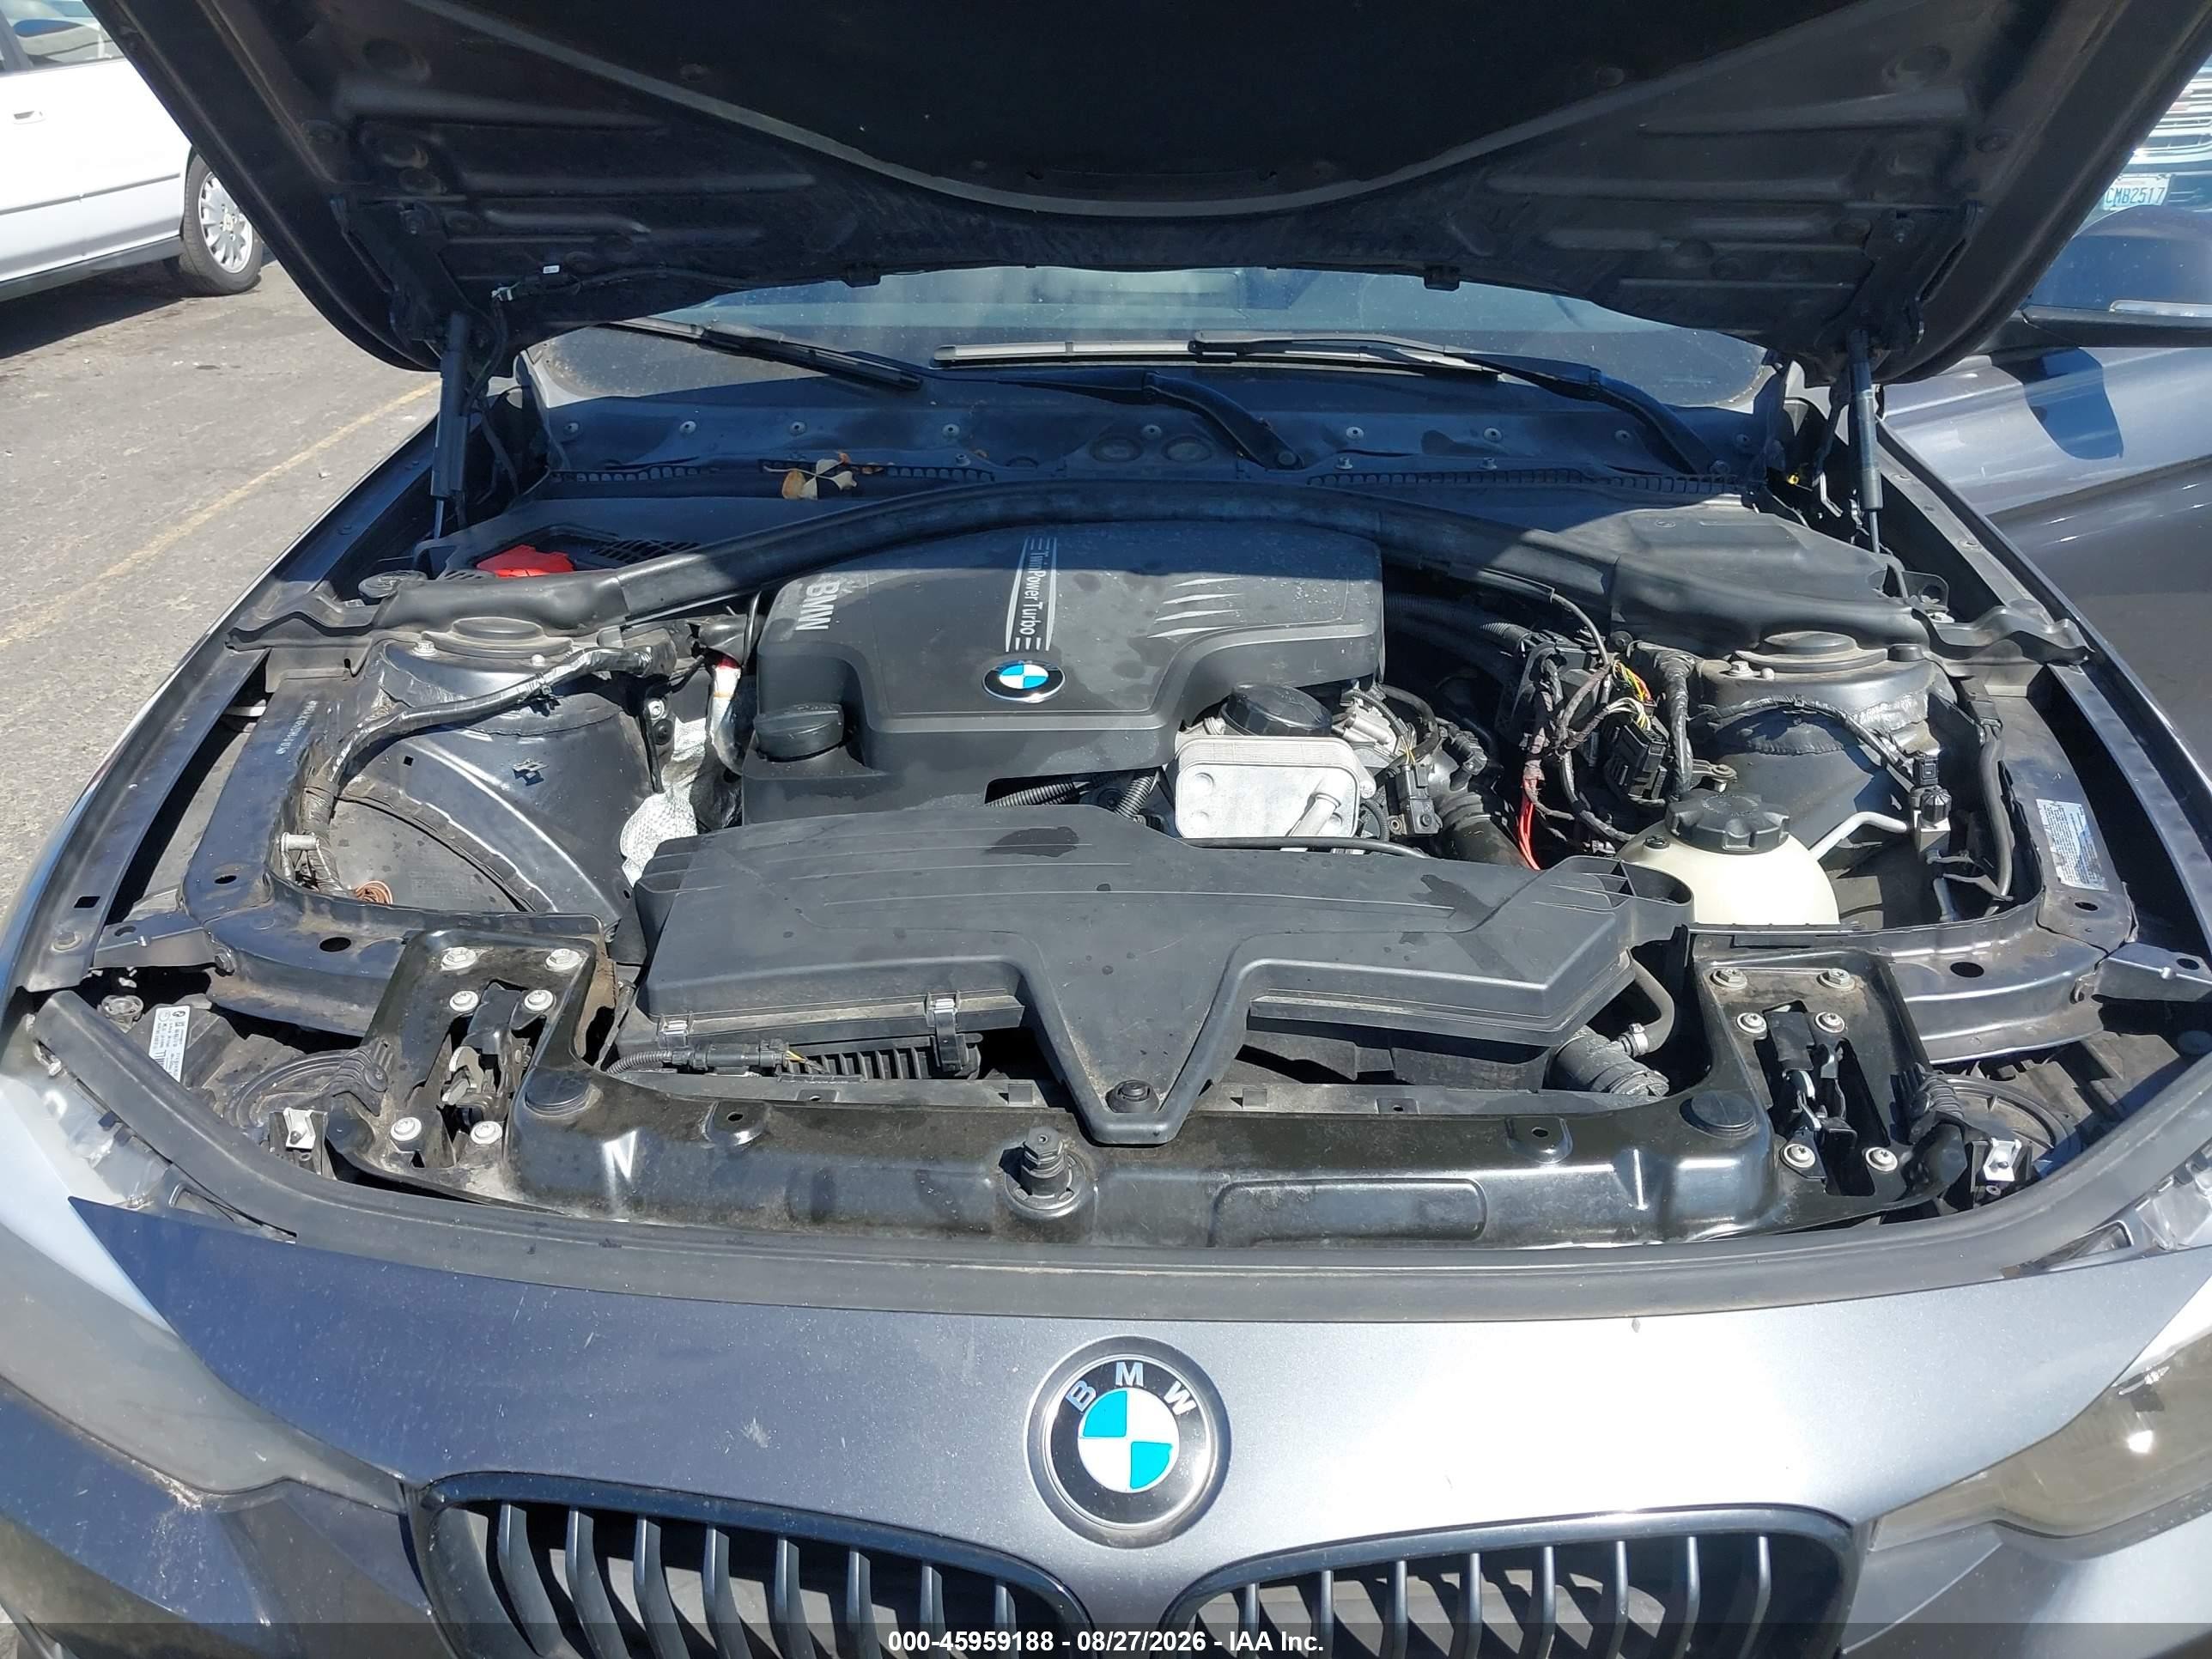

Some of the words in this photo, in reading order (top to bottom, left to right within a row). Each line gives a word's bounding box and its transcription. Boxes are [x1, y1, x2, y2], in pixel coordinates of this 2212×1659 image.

[795, 580, 839, 630] BMW
[1019, 602, 1043, 635] Turbo
[1066, 1362, 1196, 1416] BMW
